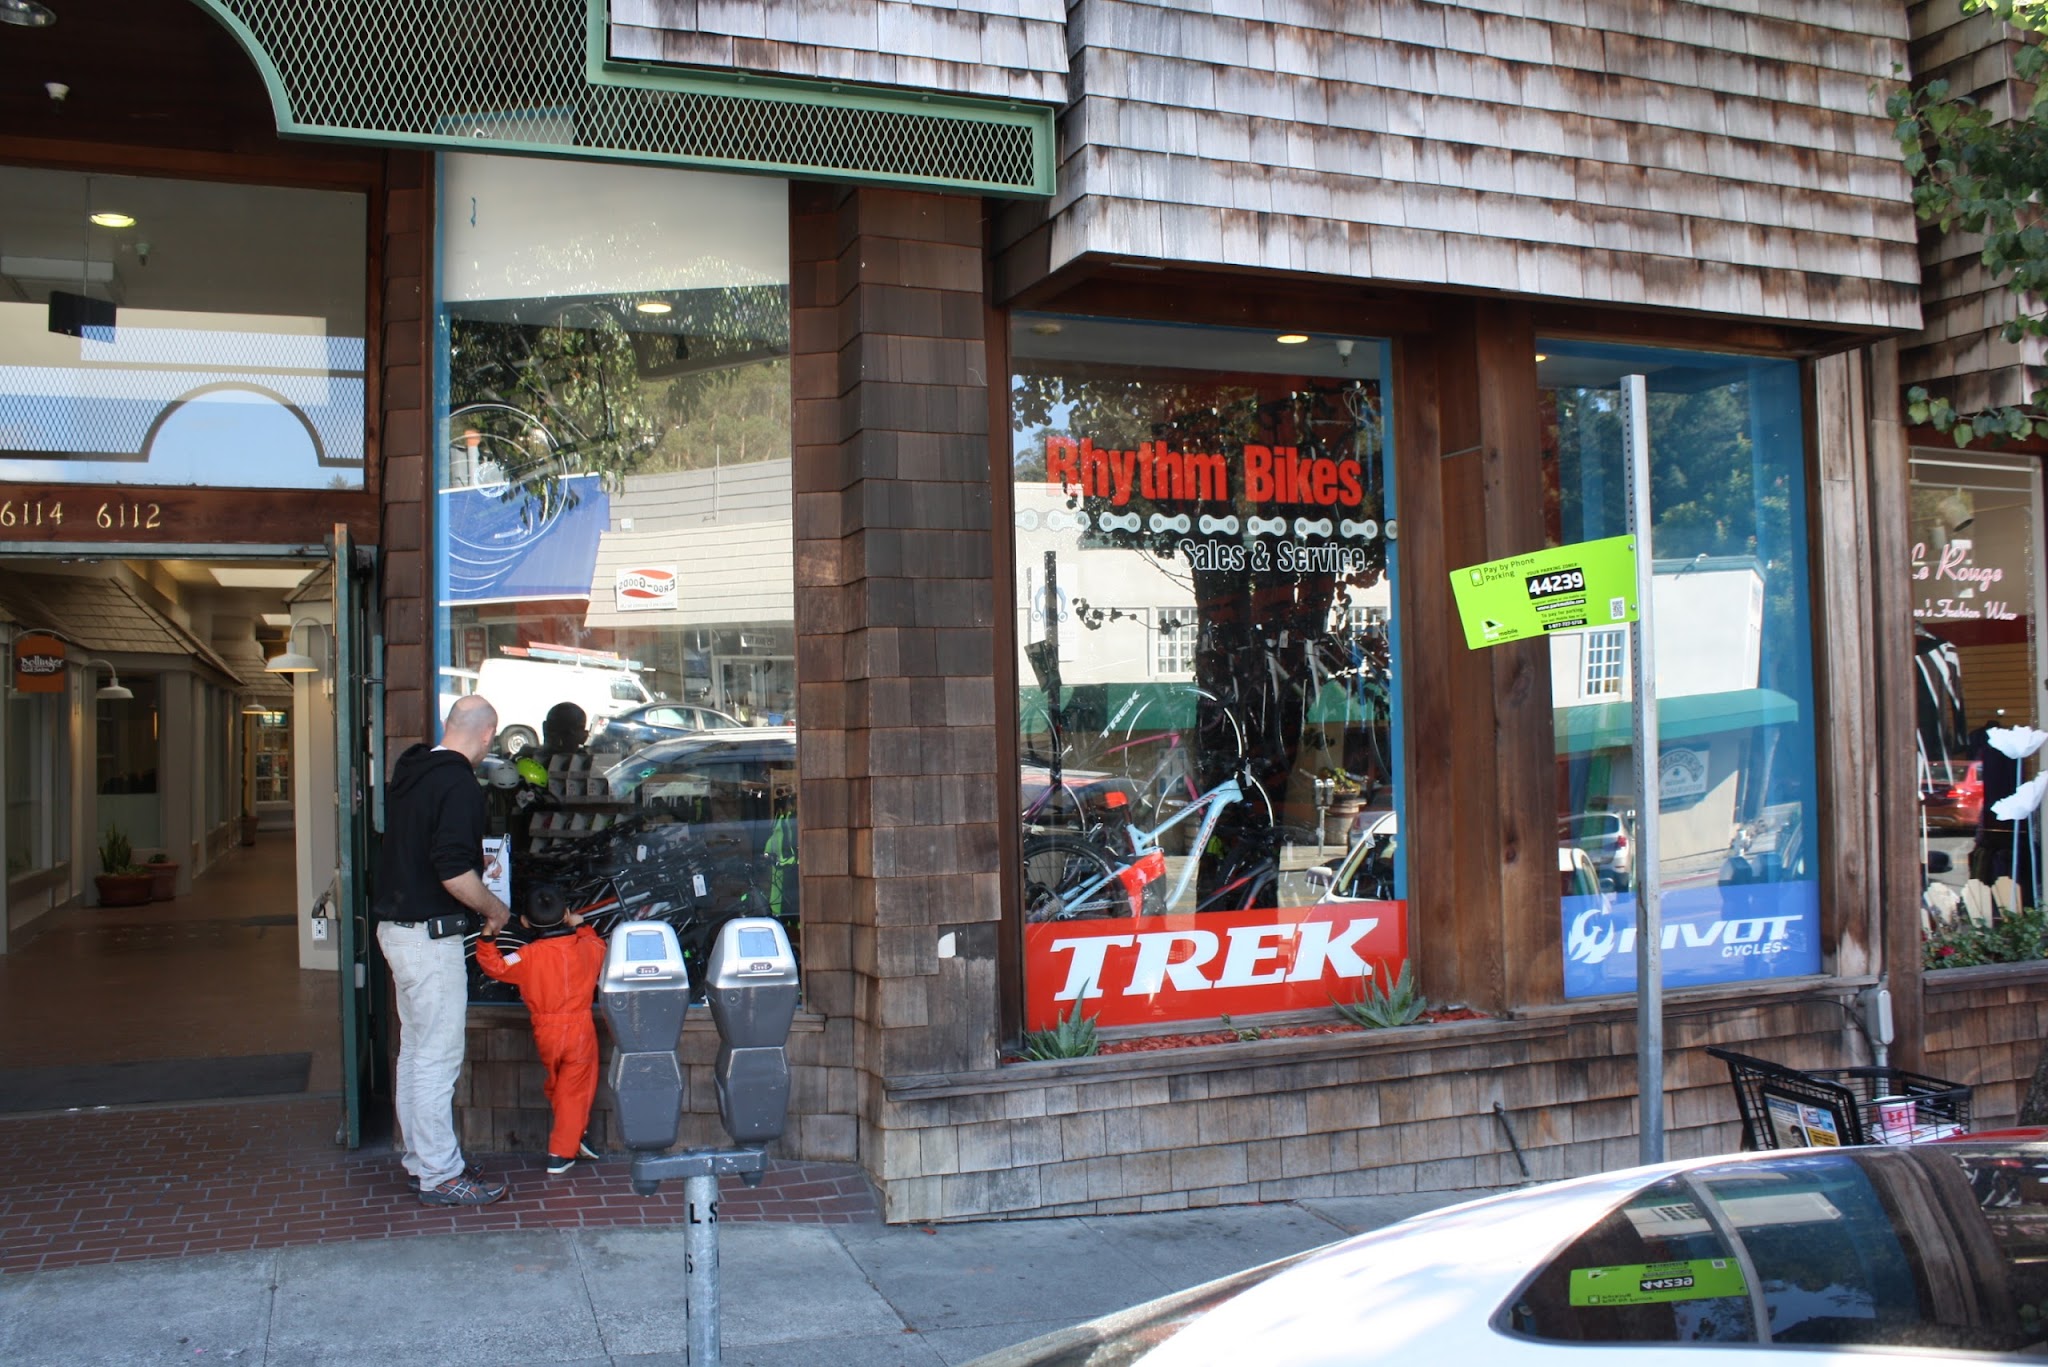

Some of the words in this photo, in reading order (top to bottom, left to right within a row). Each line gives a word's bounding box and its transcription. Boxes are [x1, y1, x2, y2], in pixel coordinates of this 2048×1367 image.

[1045, 436, 1228, 506] Rhythm
[1244, 444, 1363, 506] Bikes
[0, 500, 63, 527] 6114
[97, 503, 161, 528] 6112
[1178, 538, 1246, 572] Sales
[1250, 541, 1270, 571] &
[1276, 540, 1365, 573] Service
[1483, 566, 1498, 574] Pay
[1499, 563, 1509, 571] by
[1510, 558, 1535, 568] Phone
[1935, 543, 2003, 592] Rouge
[1485, 570, 1516, 582] Parking
[1529, 572, 1584, 595] 44239
[1099, 689, 1141, 738] TREK
[1050, 918, 1379, 1001] TREK
[1721, 942, 1781, 958] CYCLES
